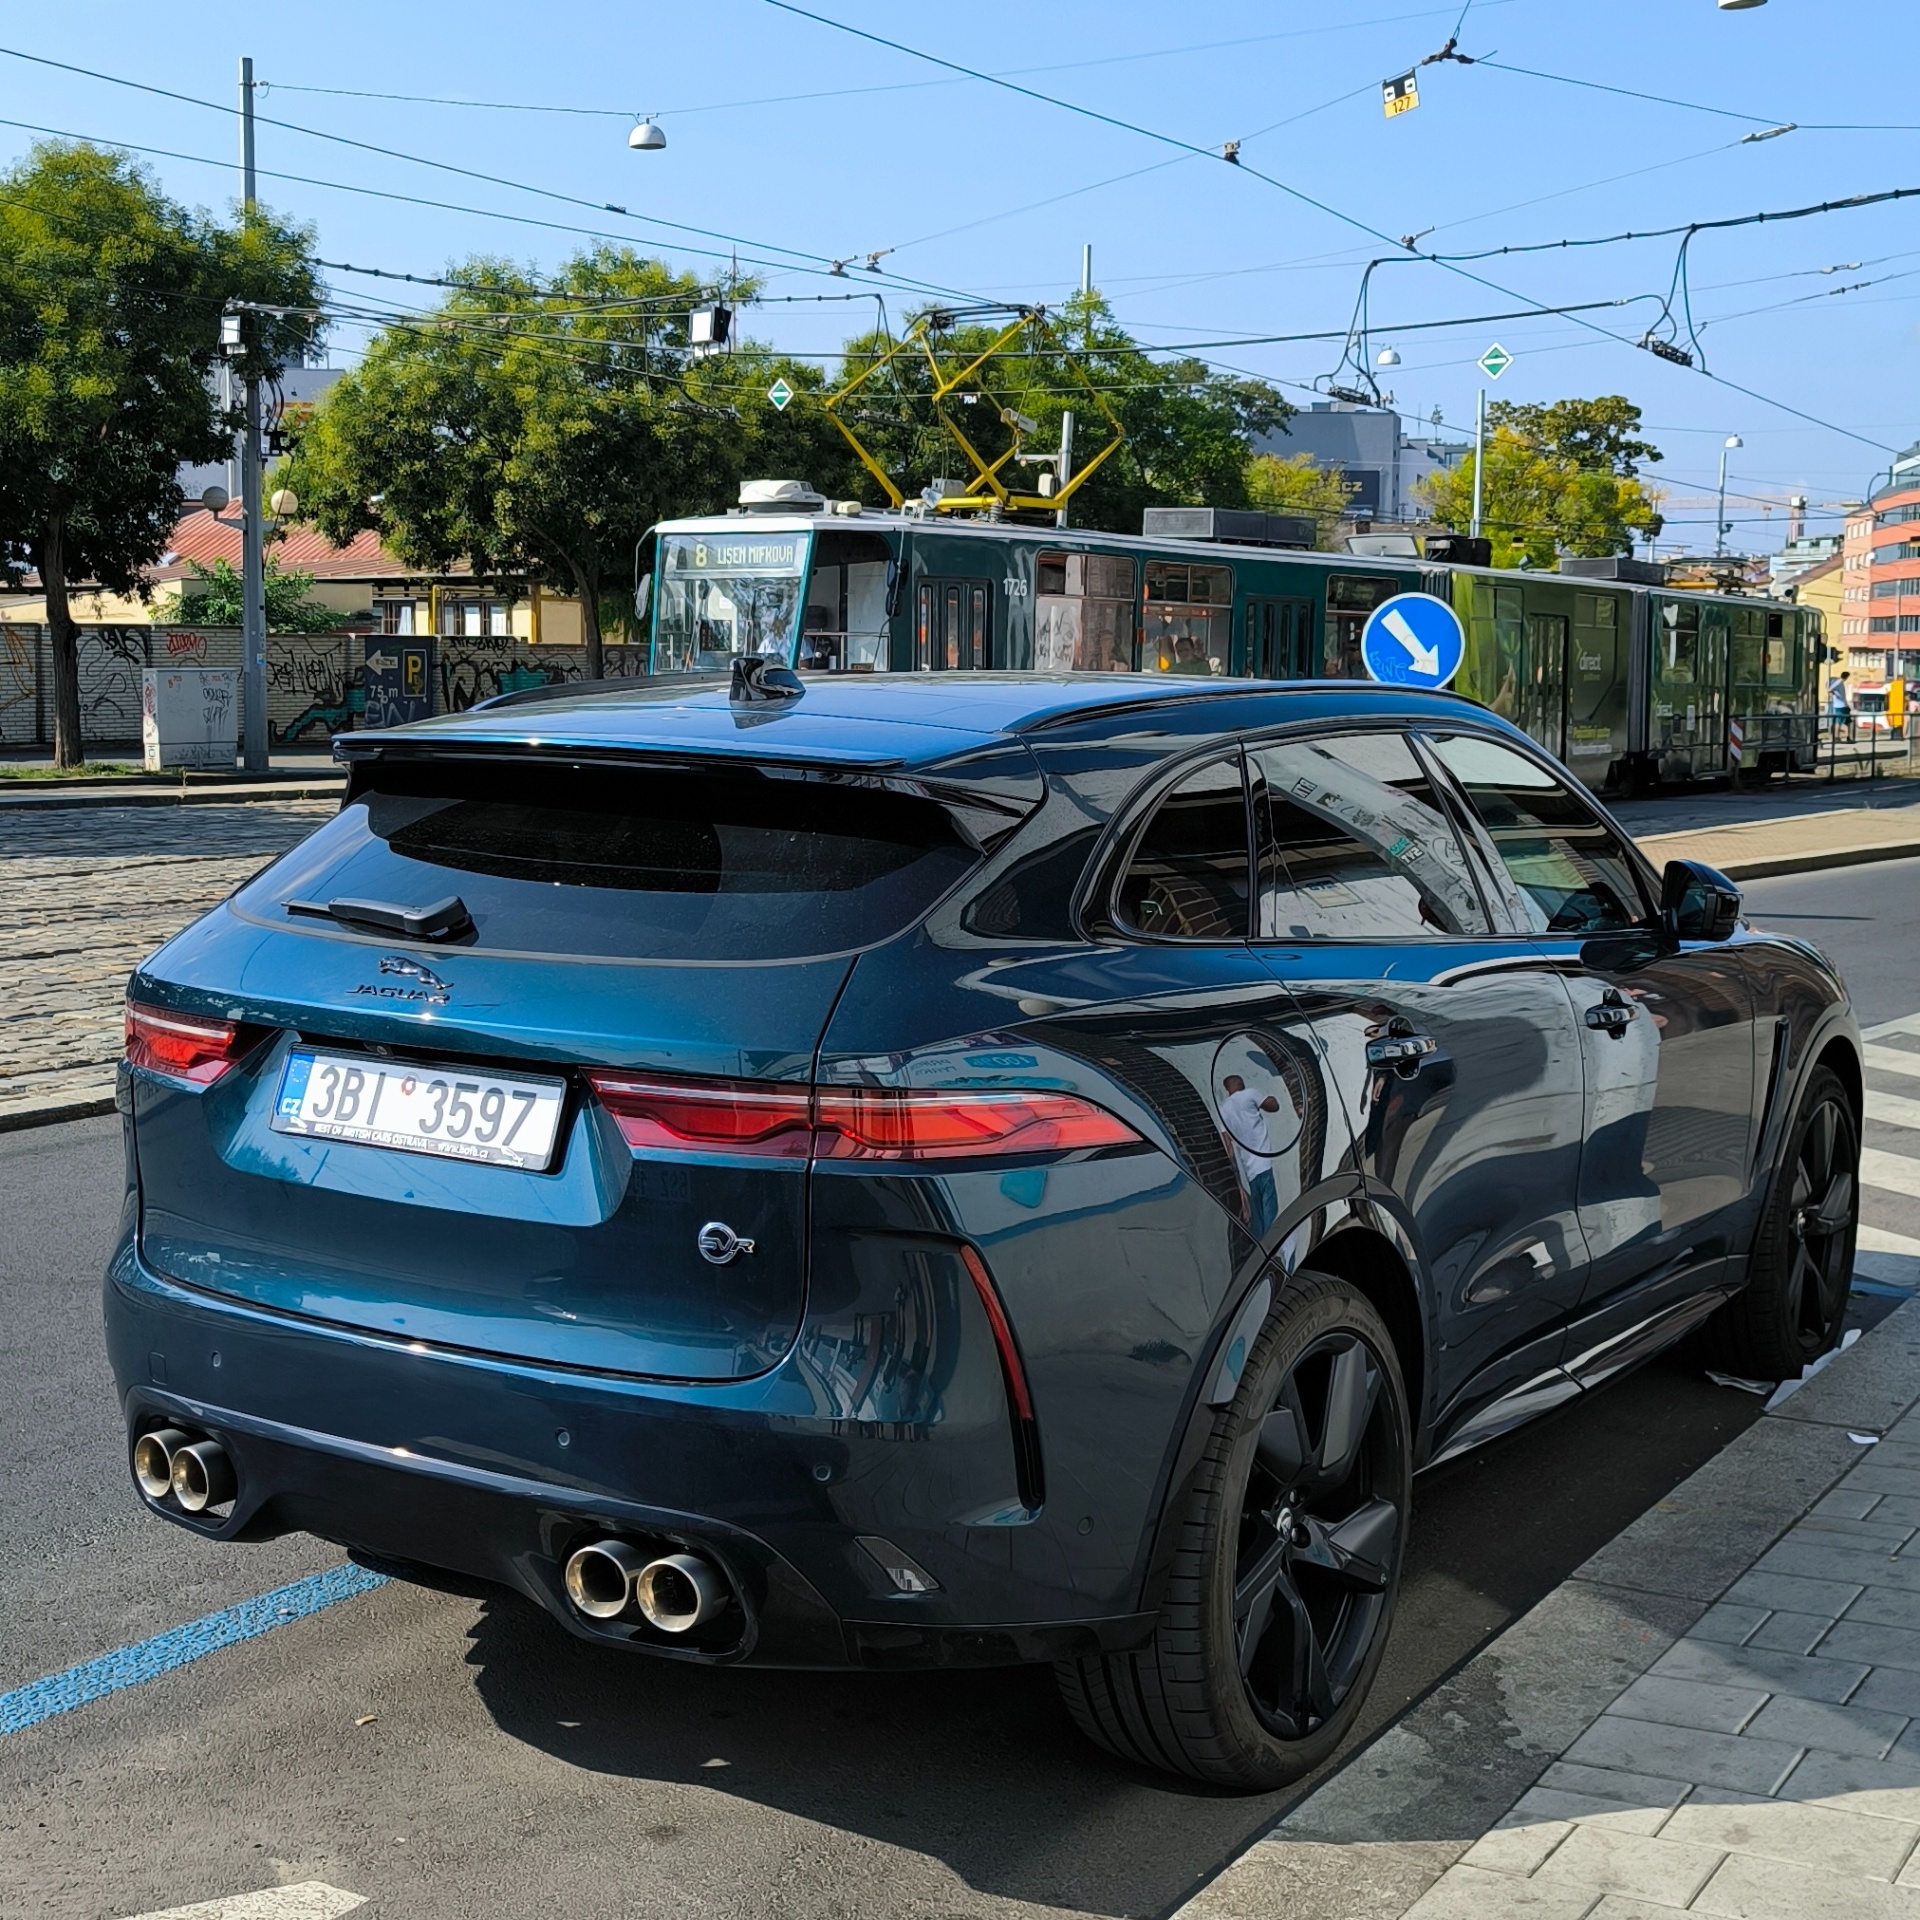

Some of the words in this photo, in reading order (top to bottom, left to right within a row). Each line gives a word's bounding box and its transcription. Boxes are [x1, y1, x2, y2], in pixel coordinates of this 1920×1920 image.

[1392, 96, 1411, 114] 127
[695, 543, 708, 567] 8
[1003, 577, 1028, 597] 1726
[407, 655, 422, 684] P
[369, 685, 384, 698] 75
[388, 687, 399, 698] m
[345, 984, 451, 1006] JAGUAR
[281, 1097, 302, 1115] CZ
[312, 1064, 387, 1126] 3BI
[418, 1079, 538, 1147] 3597
[314, 1123, 332, 1134] BEST
[332, 1125, 343, 1136] OF
[343, 1126, 372, 1140] BRITISH
[372, 1130, 393, 1143] CARS
[393, 1134, 428, 1149] OSTRAVA
